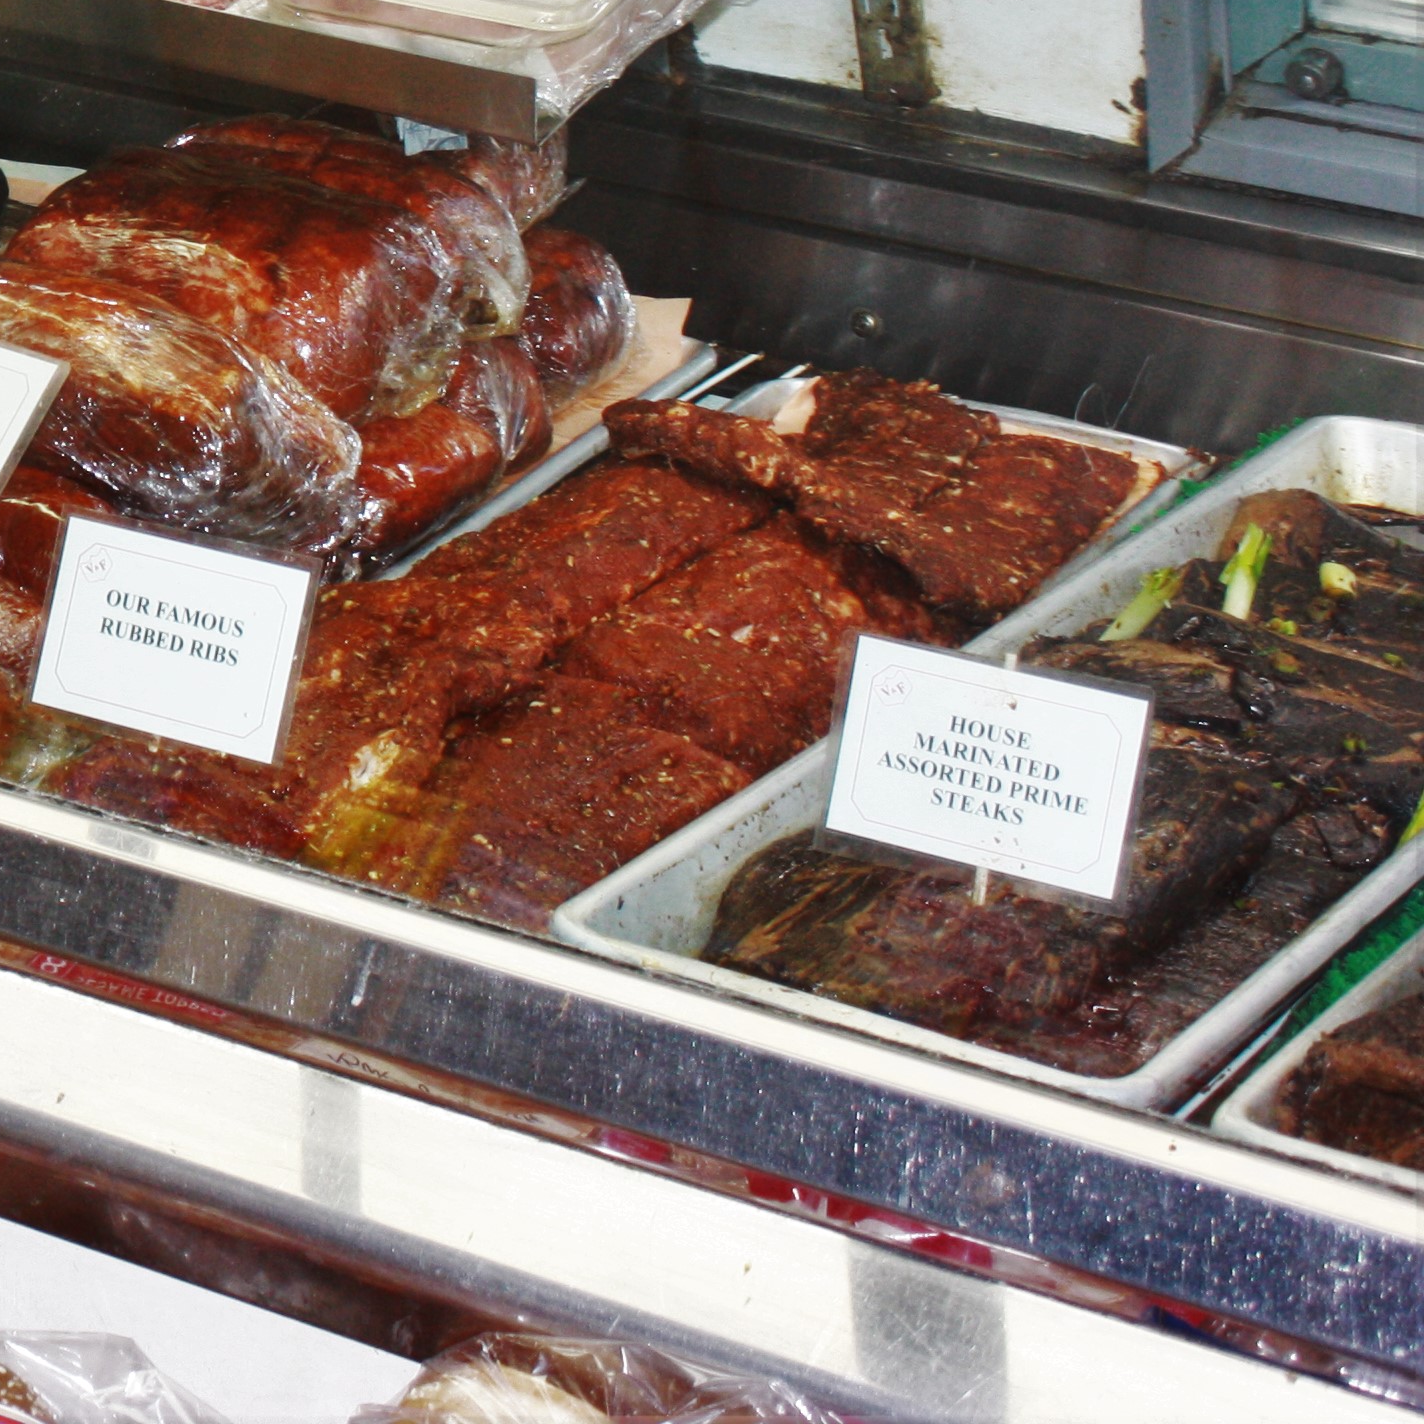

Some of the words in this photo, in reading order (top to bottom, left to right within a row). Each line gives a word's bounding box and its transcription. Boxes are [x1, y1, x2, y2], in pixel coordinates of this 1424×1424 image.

[105, 589, 150, 616] OUR
[155, 602, 245, 638] FAMOUS
[99, 616, 184, 653] RUBBED
[189, 638, 240, 667] RIBS
[949, 715, 1032, 749] HOUSE
[913, 732, 1060, 782] MARINATED
[877, 751, 1002, 794] ASSORTED
[1009, 781, 1089, 815] PRIME
[930, 788, 1024, 825] STEAKS
